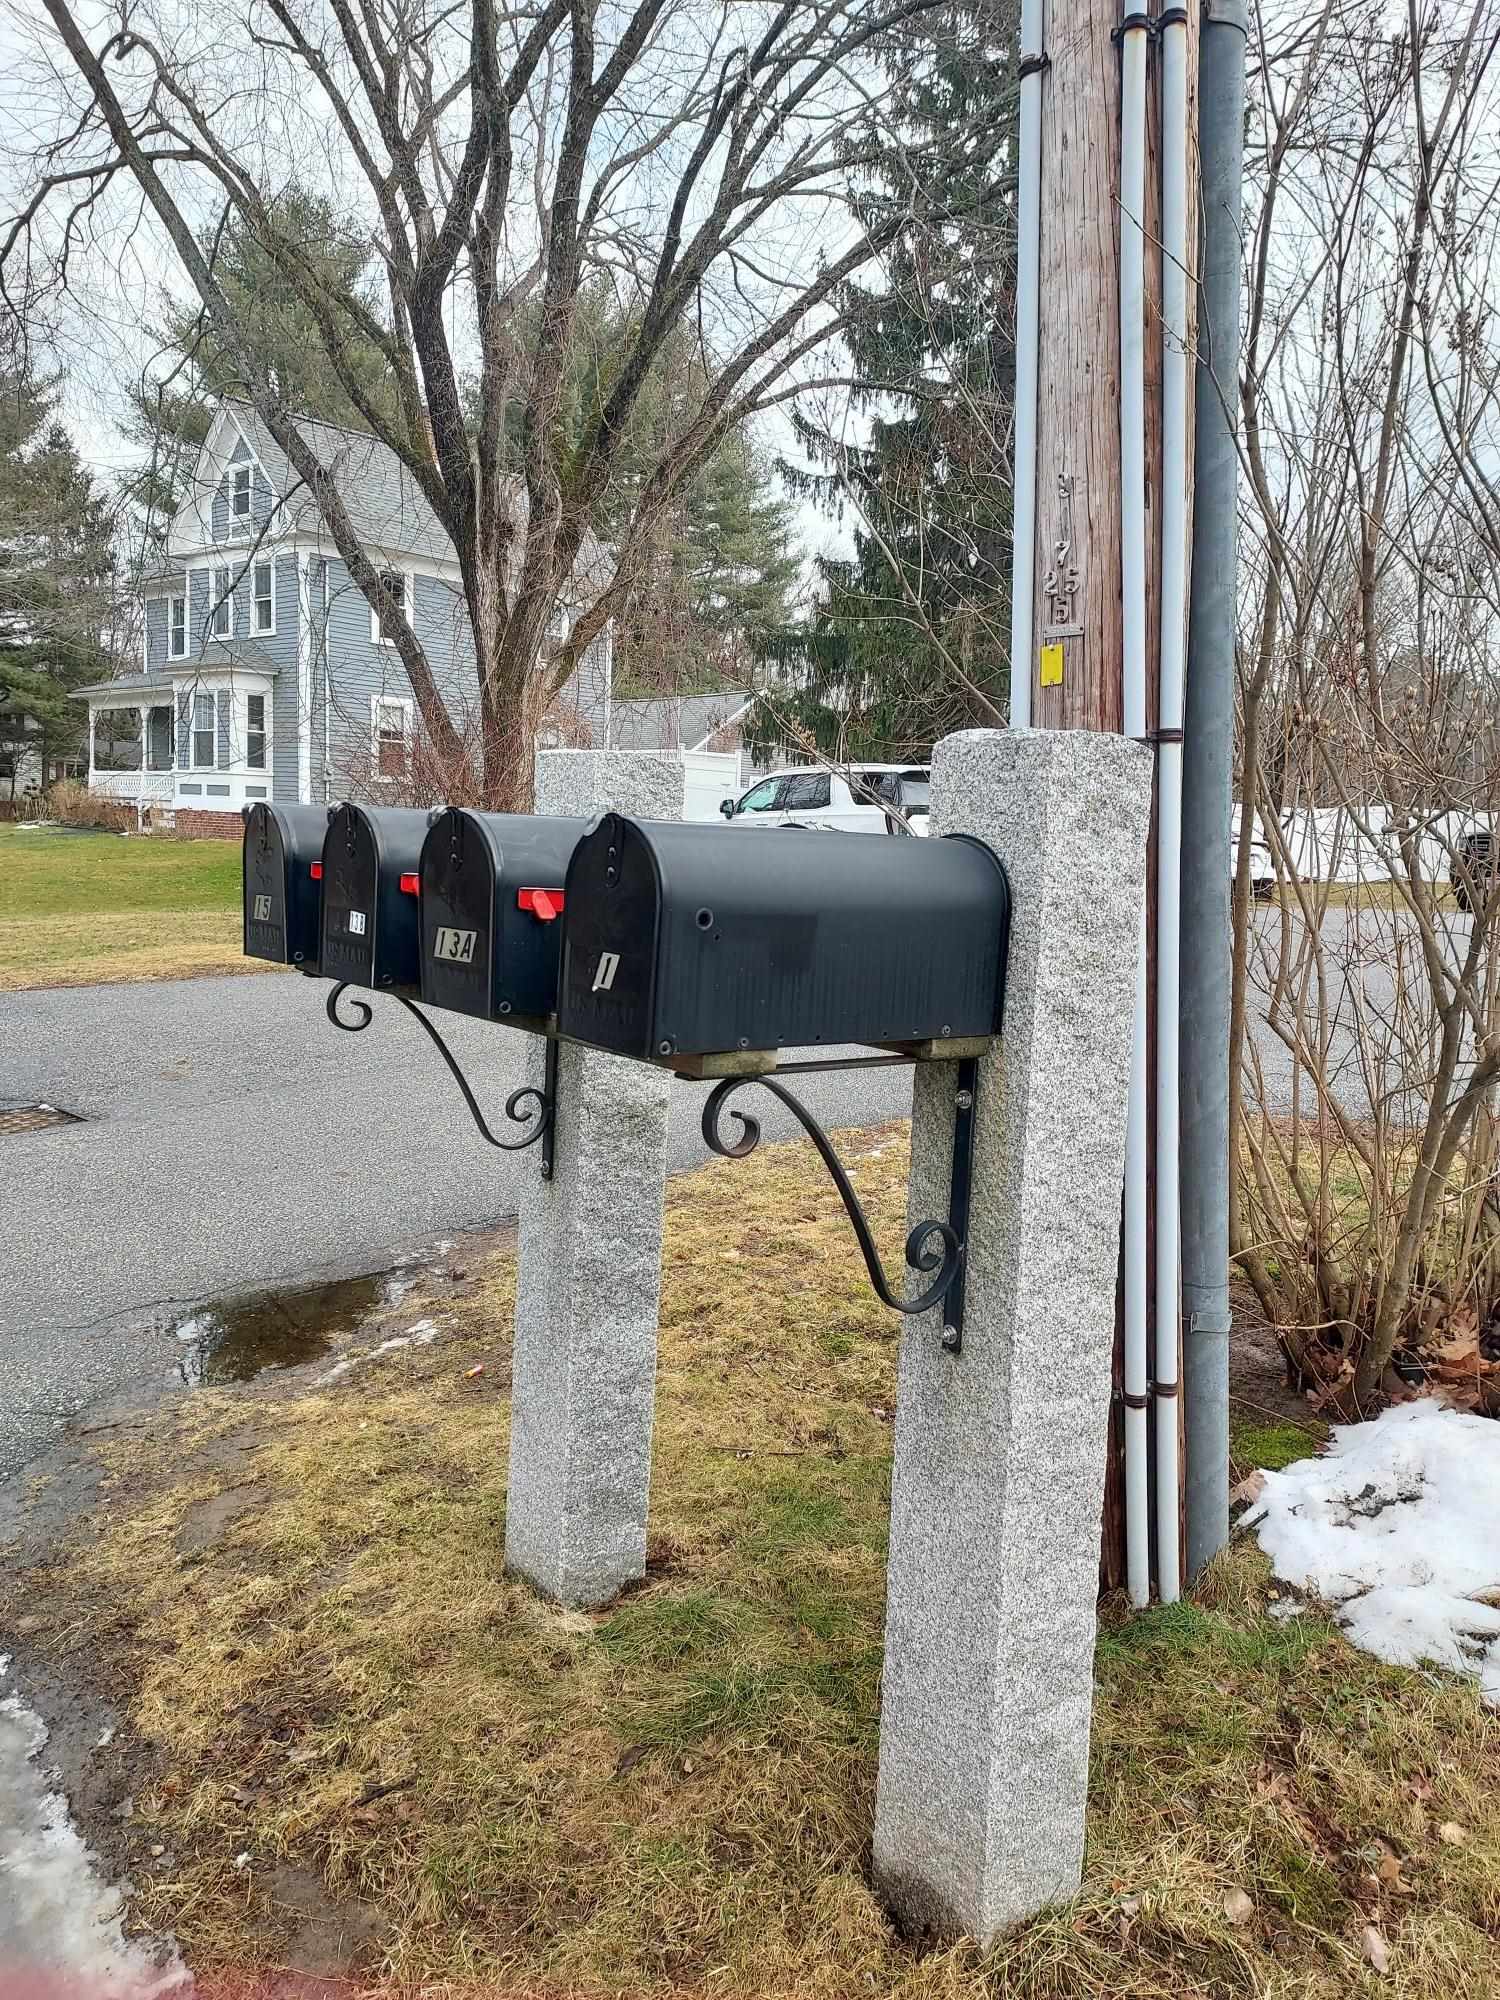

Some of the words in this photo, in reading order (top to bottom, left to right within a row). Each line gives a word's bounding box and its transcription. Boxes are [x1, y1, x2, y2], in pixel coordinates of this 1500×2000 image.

[1055, 540, 1071, 567] 7
[255, 896, 270, 919] 15
[439, 931, 472, 959] 13A
